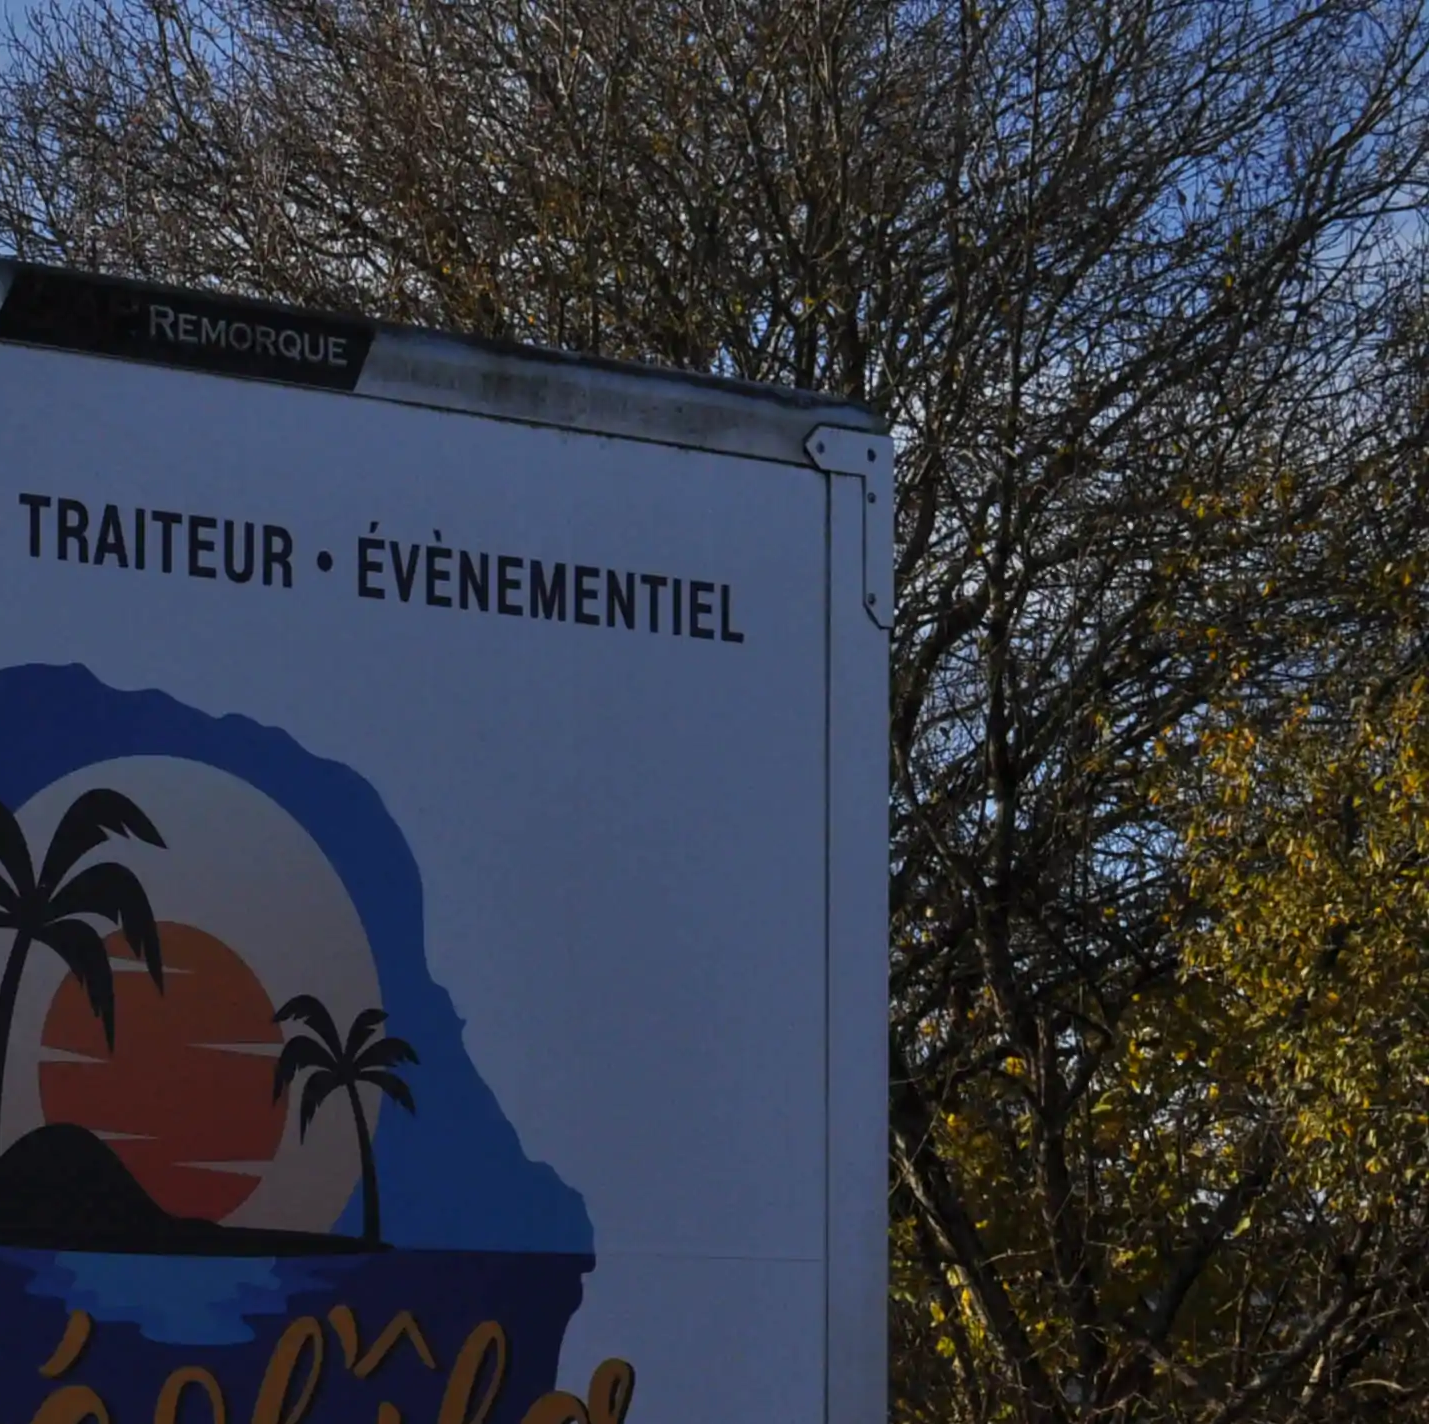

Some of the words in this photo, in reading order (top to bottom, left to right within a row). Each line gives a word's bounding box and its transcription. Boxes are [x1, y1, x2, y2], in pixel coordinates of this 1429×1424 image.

[147, 304, 349, 367] REMORQUE
[18, 492, 293, 589] TRAITEUR
[357, 521, 745, 644] ÉVÈNEMENTIEL
